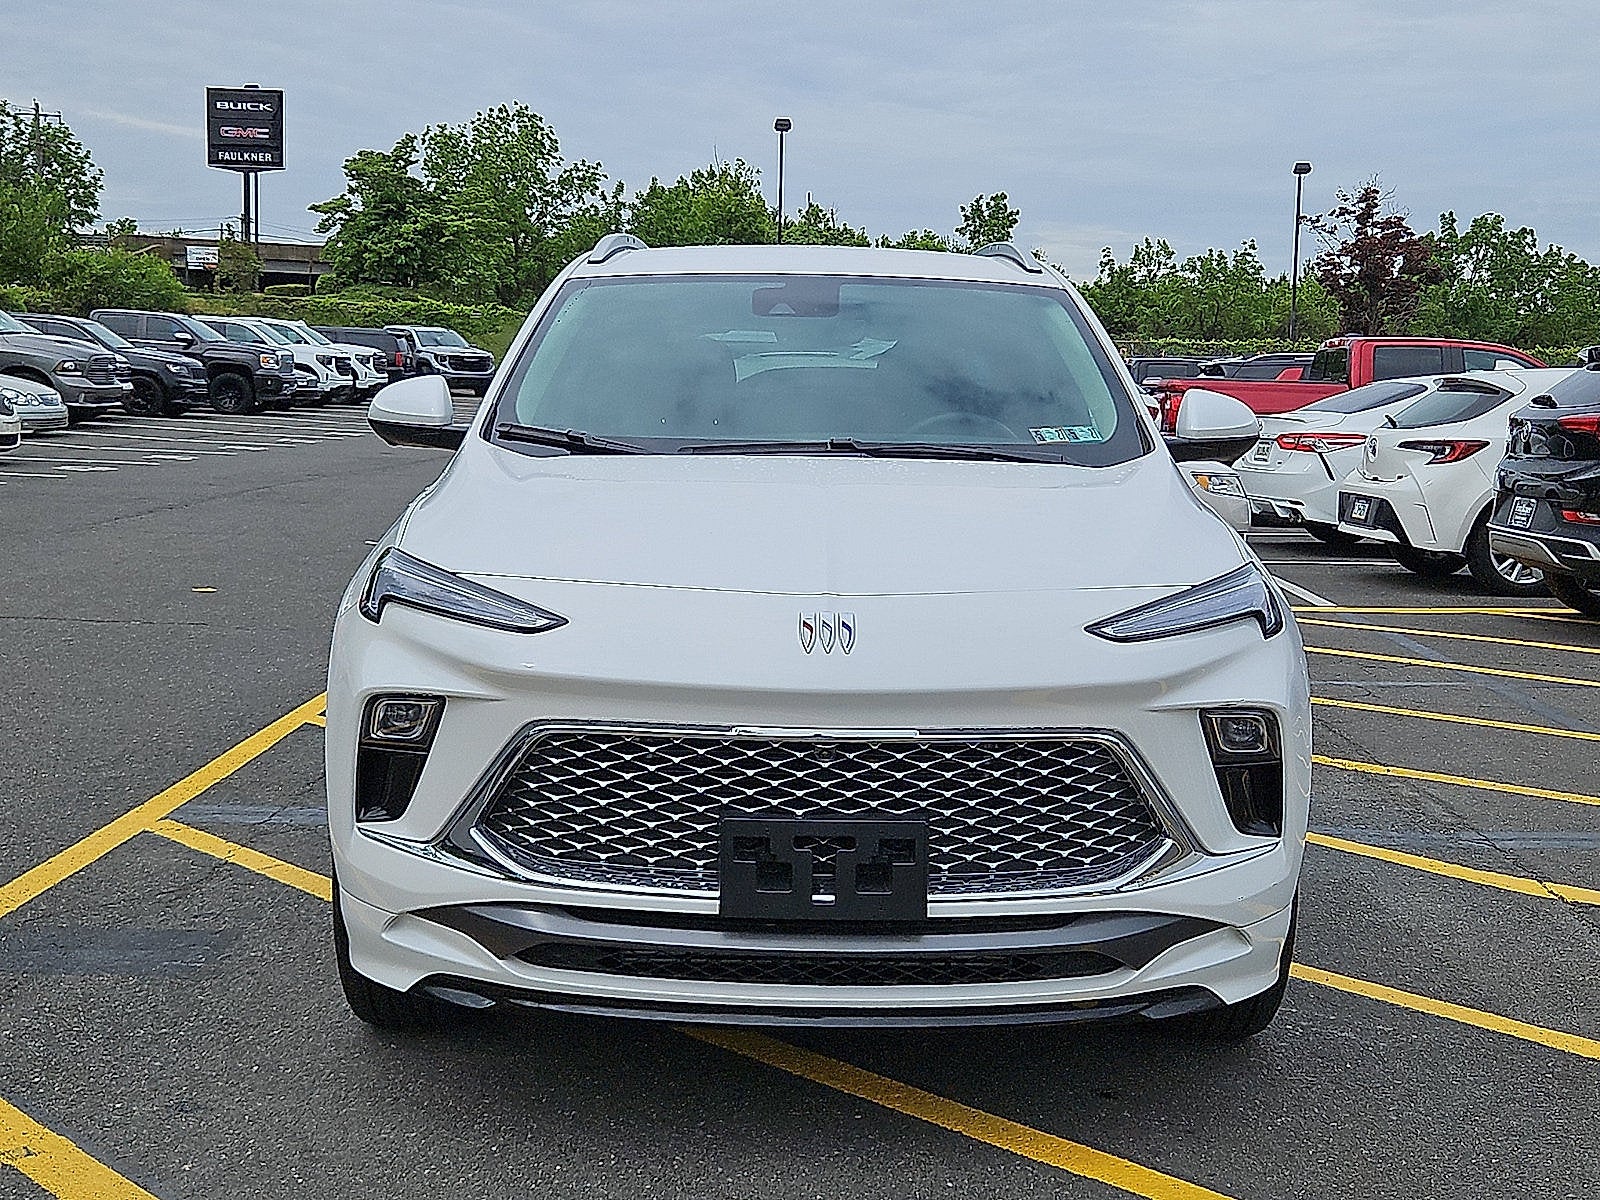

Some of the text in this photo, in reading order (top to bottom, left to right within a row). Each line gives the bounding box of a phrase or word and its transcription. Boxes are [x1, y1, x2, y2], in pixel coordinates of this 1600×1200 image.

[216, 101, 273, 111] BUICK
[220, 126, 270, 138] GMC
[218, 151, 272, 162] FAULKNER
